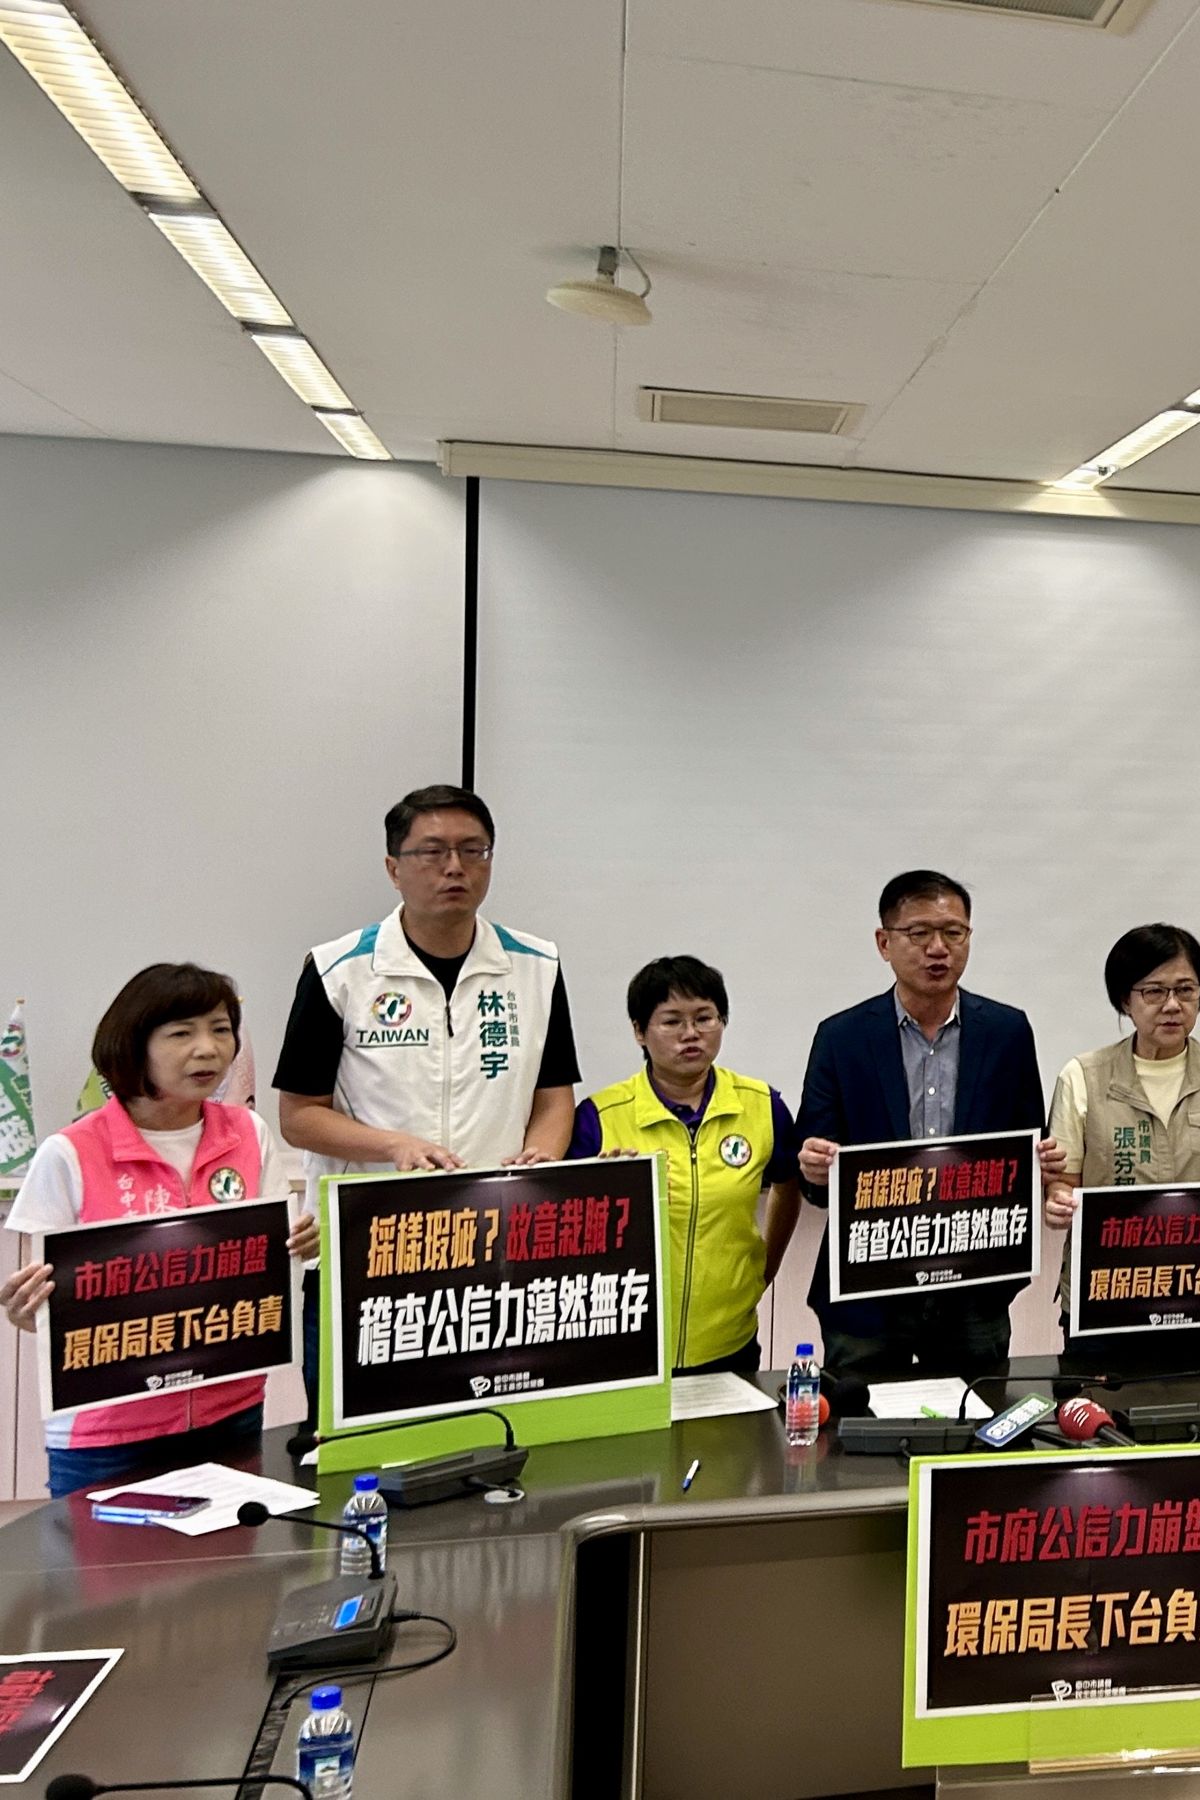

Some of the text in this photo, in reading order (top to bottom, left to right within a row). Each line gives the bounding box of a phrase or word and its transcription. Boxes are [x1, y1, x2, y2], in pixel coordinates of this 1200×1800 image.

[356, 1029, 429, 1044] TAIWAN
[478, 990, 509, 1080] 林德宇
[75, 1234, 268, 1300] 市府公信力崩盤
[848, 1204, 1028, 1264] 稽查公信力蕩然無存
[62, 1295, 284, 1372] 環保局長下台負責
[357, 1268, 650, 1367] 稽查公信力蕩然無存
